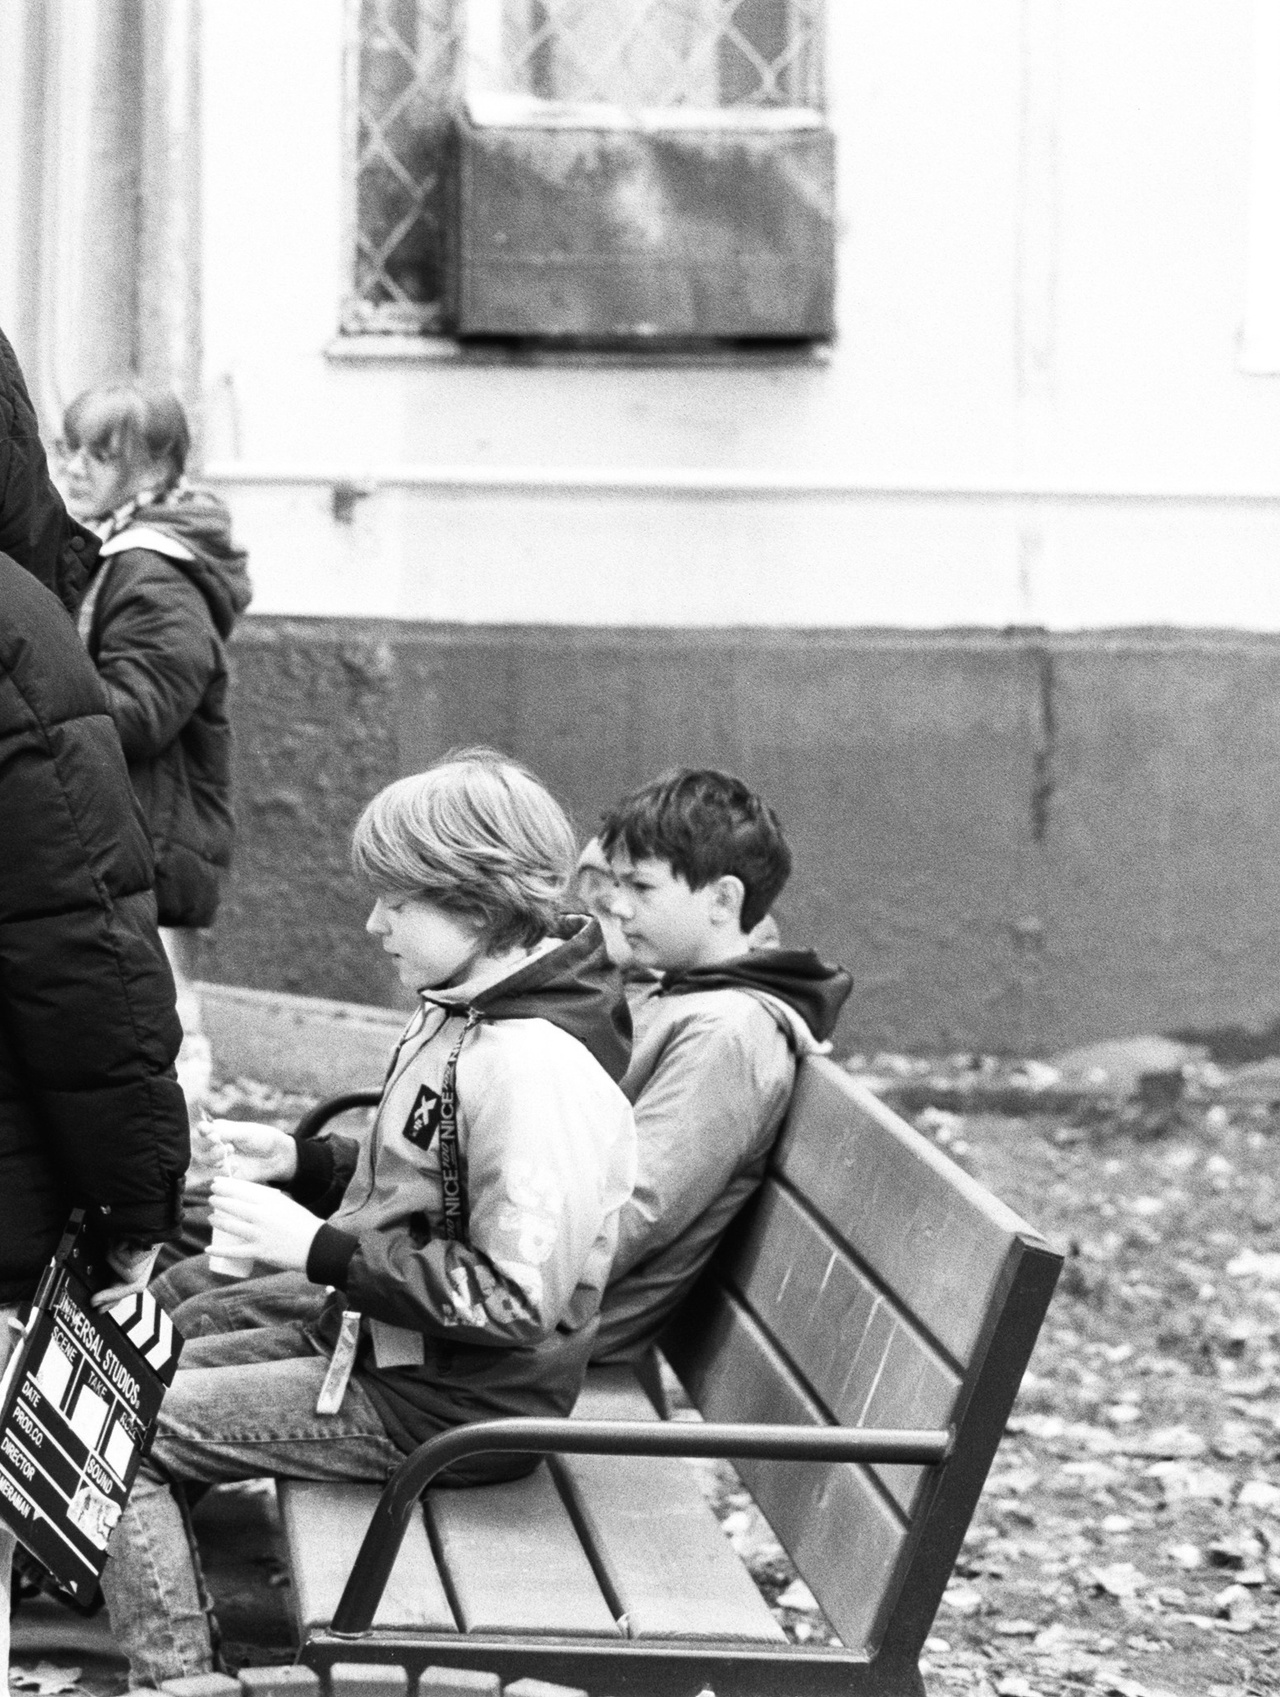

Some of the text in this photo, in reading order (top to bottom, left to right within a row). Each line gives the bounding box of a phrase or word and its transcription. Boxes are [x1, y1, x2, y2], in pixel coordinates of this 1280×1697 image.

[440, 1091, 456, 1138] NICE
[443, 1169, 461, 1216] NICE
[51, 1326, 78, 1362] SCENE
[22, 1380, 42, 1408] DATE
[88, 1370, 108, 1399] TAKE
[0, 1437, 36, 1481] DIRECTOR
[86, 1458, 114, 1494] SOUND
